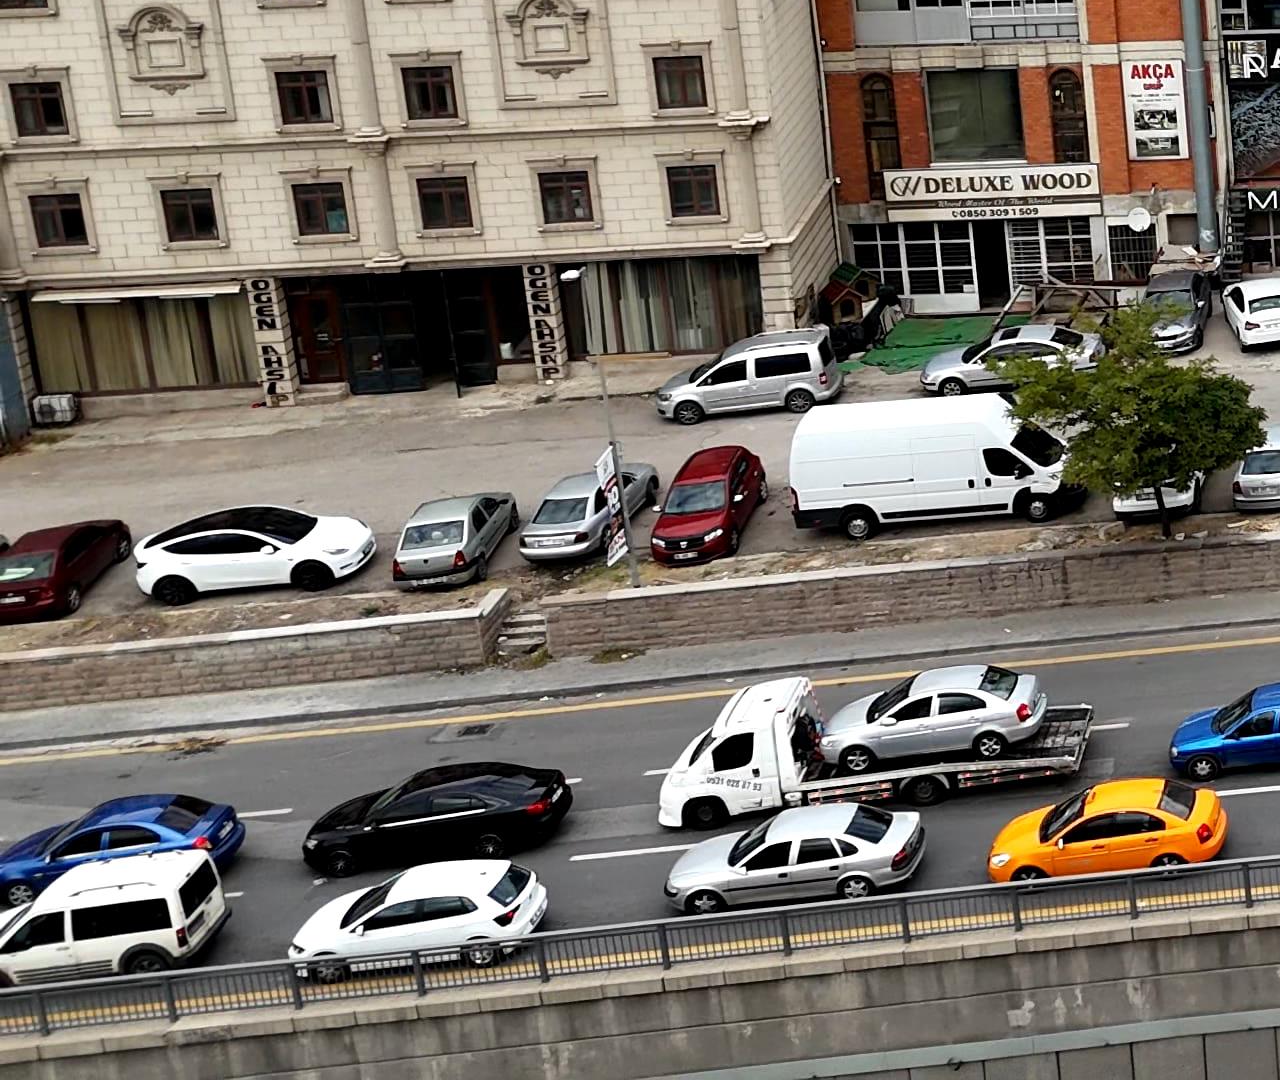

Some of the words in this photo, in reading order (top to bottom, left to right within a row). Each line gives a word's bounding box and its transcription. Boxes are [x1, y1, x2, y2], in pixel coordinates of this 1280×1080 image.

[1131, 64, 1174, 82] AKÇA
[924, 175, 1014, 194] DELUXE
[1020, 172, 1092, 190] WOOD
[959, 210, 987, 218] 0850
